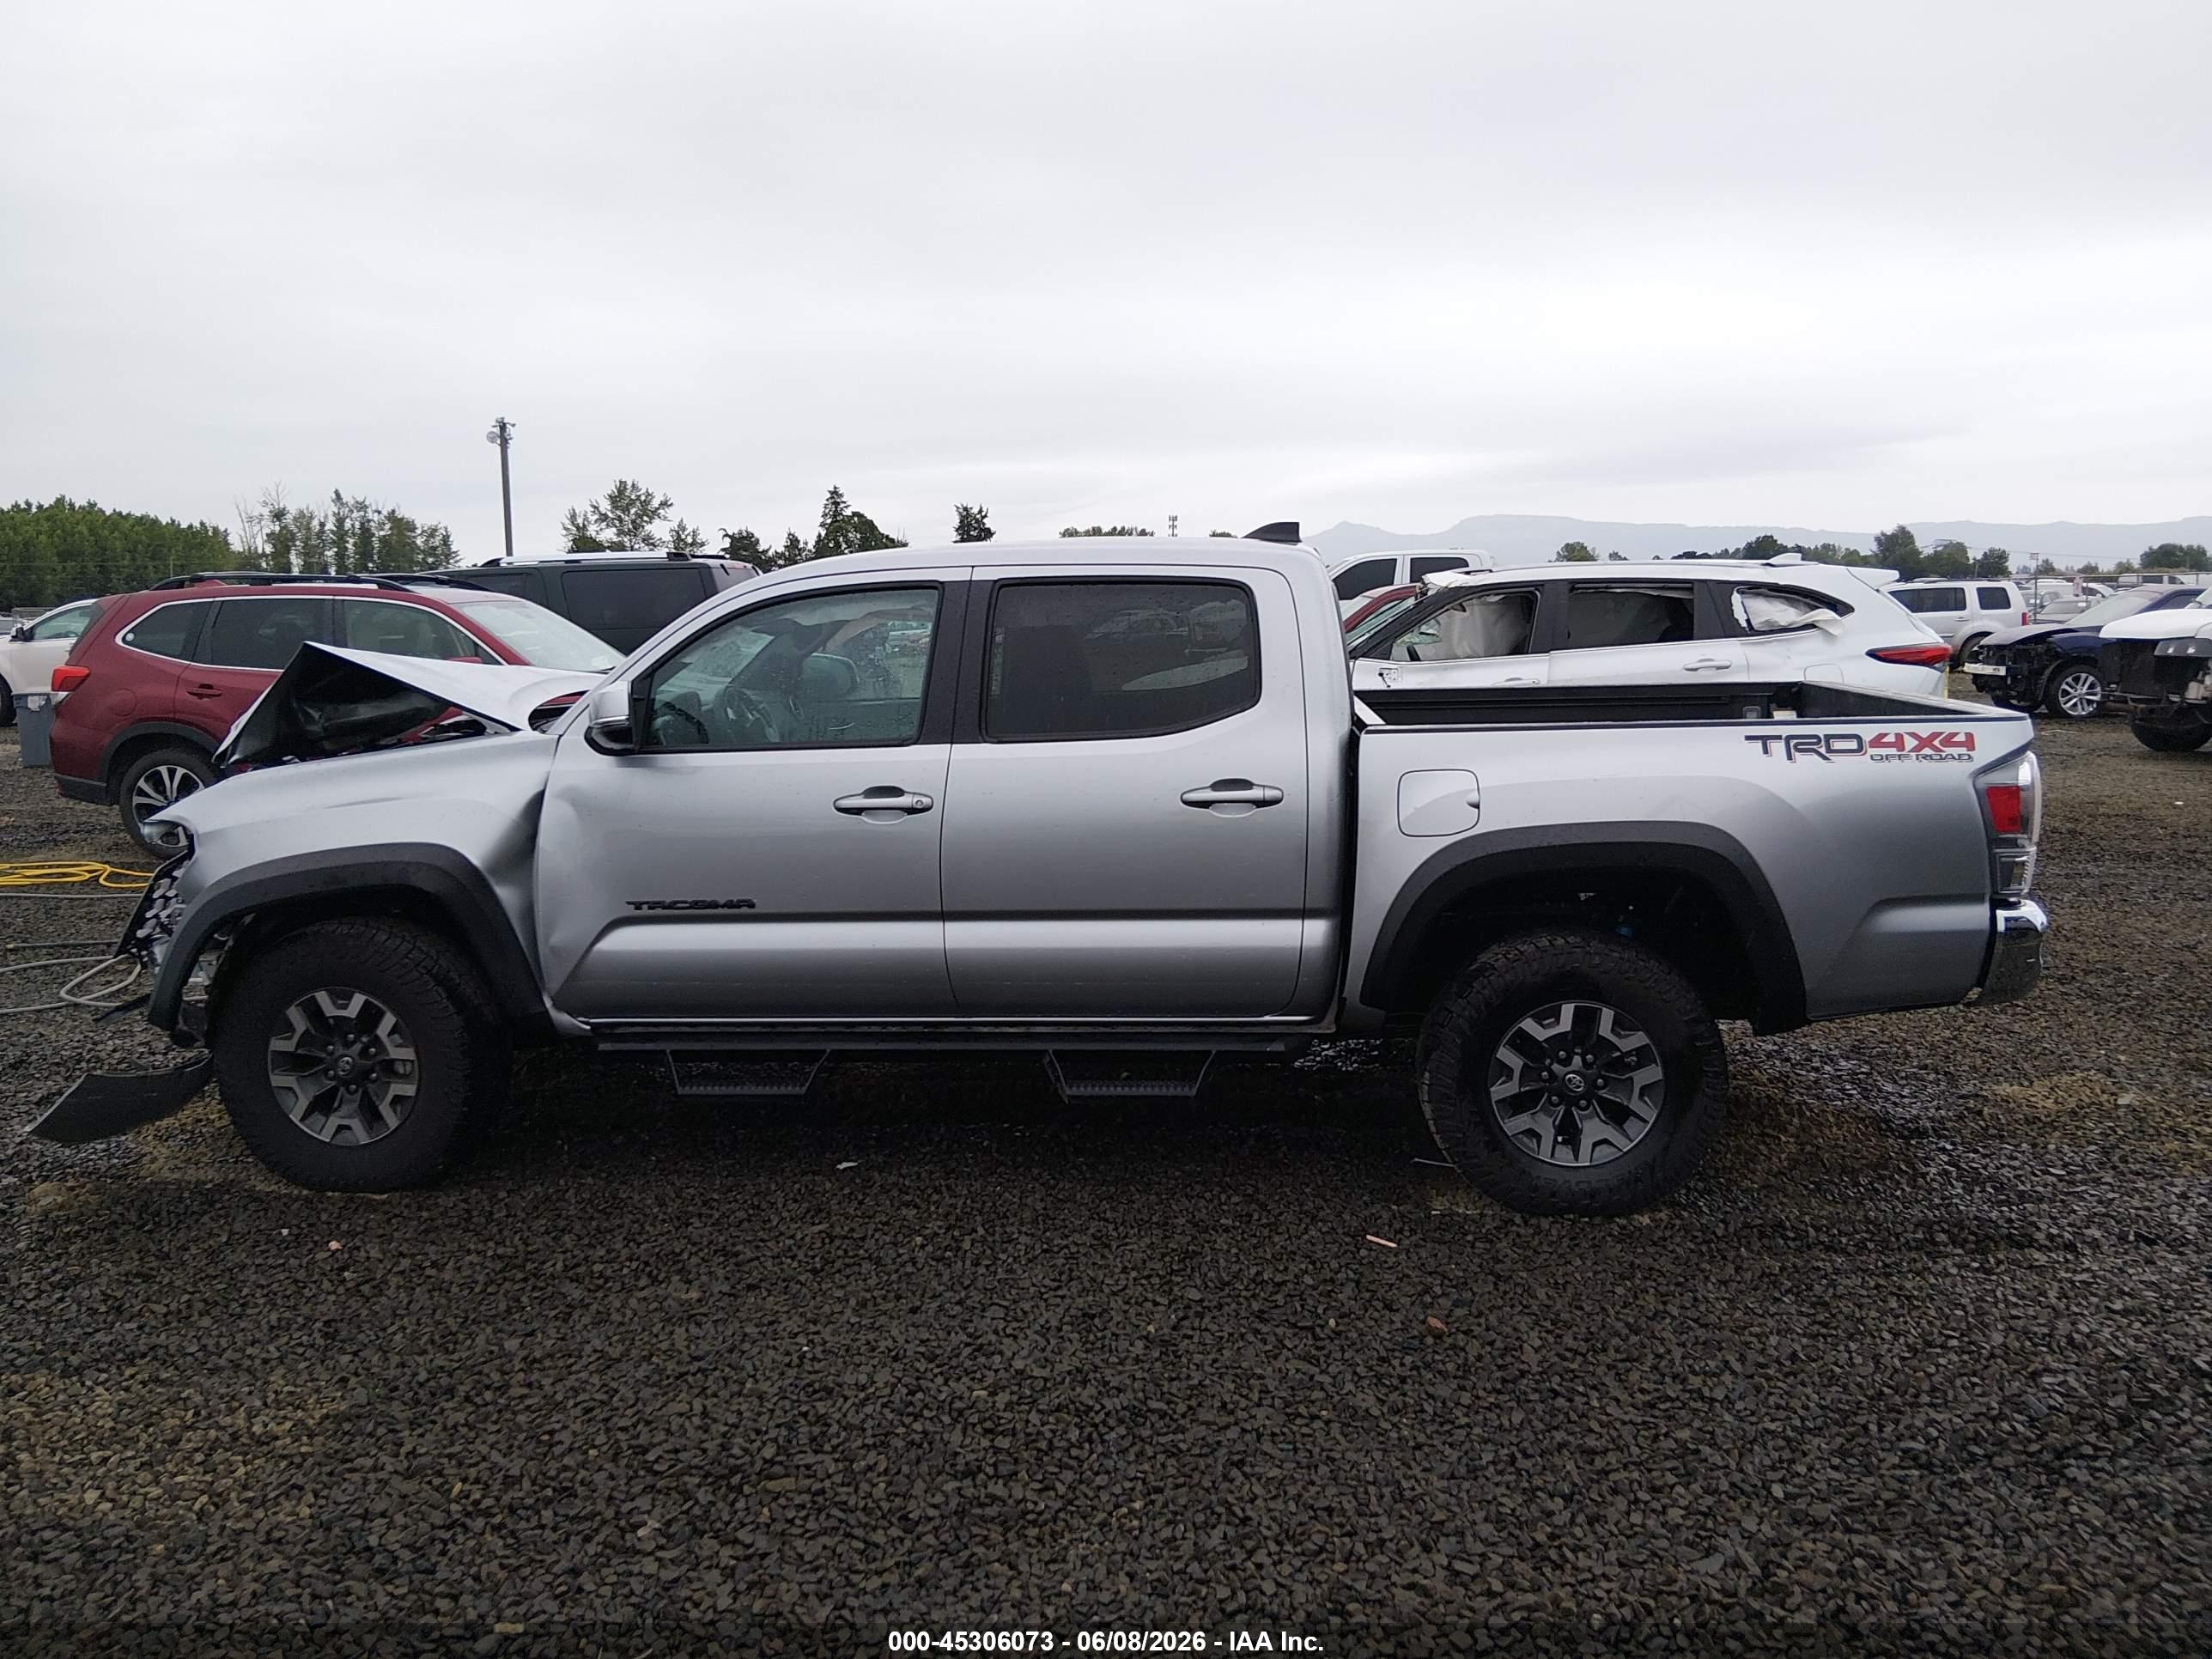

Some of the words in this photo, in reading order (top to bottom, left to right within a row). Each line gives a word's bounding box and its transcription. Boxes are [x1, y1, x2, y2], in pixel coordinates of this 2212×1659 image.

[1744, 733, 1867, 763] TRD
[1868, 732, 1975, 752] 4X4
[1870, 753, 1912, 762] OFF
[1915, 753, 1973, 762] ROAD
[626, 899, 756, 910] TACOMA
